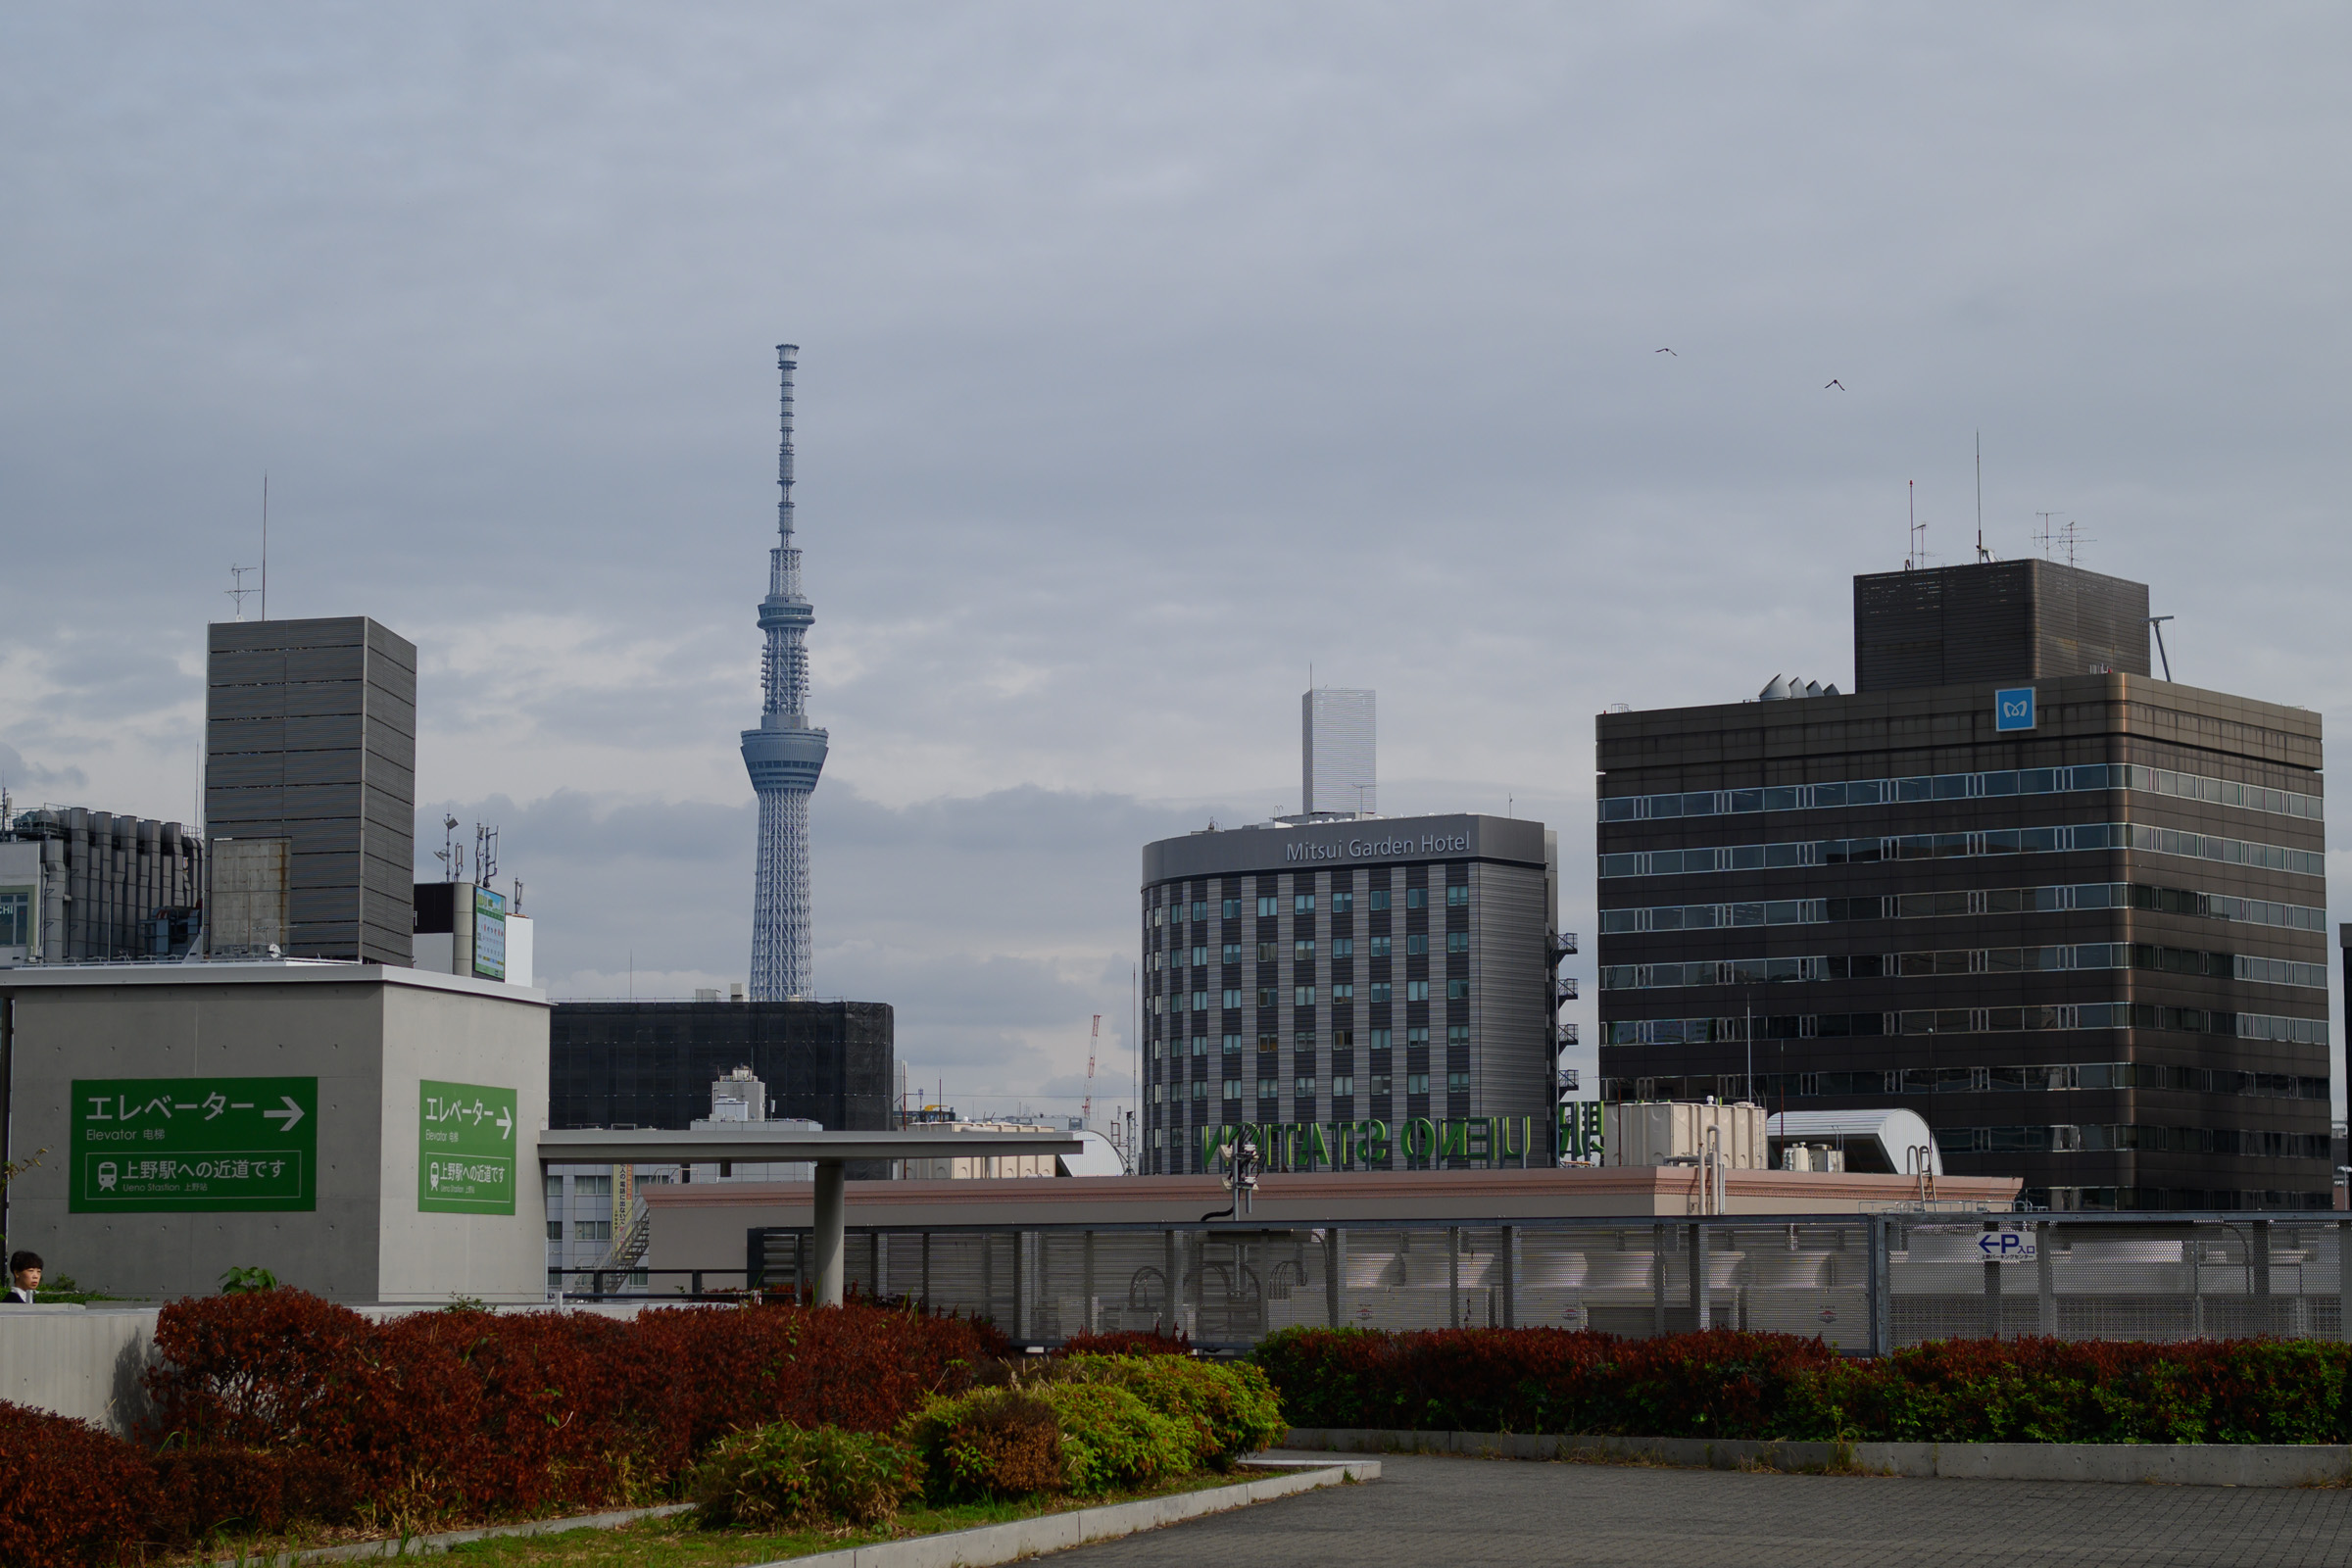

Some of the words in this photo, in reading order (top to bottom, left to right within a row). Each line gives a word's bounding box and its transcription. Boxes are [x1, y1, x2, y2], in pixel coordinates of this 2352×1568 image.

[1287, 840, 1343, 861] Mitsui
[1348, 836, 1414, 858] Garden
[1421, 831, 1470, 853] Hotel
[86, 1091, 254, 1121] エレベーター
[425, 1097, 494, 1126] エレベーター
[86, 1129, 137, 1140] Elevator
[143, 1129, 166, 1140] 电梯
[122, 1159, 286, 1180] 上野駅への近道です
[439, 1162, 506, 1183] 上野駅への近道です
[122, 1183, 146, 1192] Ueno
[147, 1183, 180, 1192] Stastion
[2001, 1234, 2019, 1253] P
